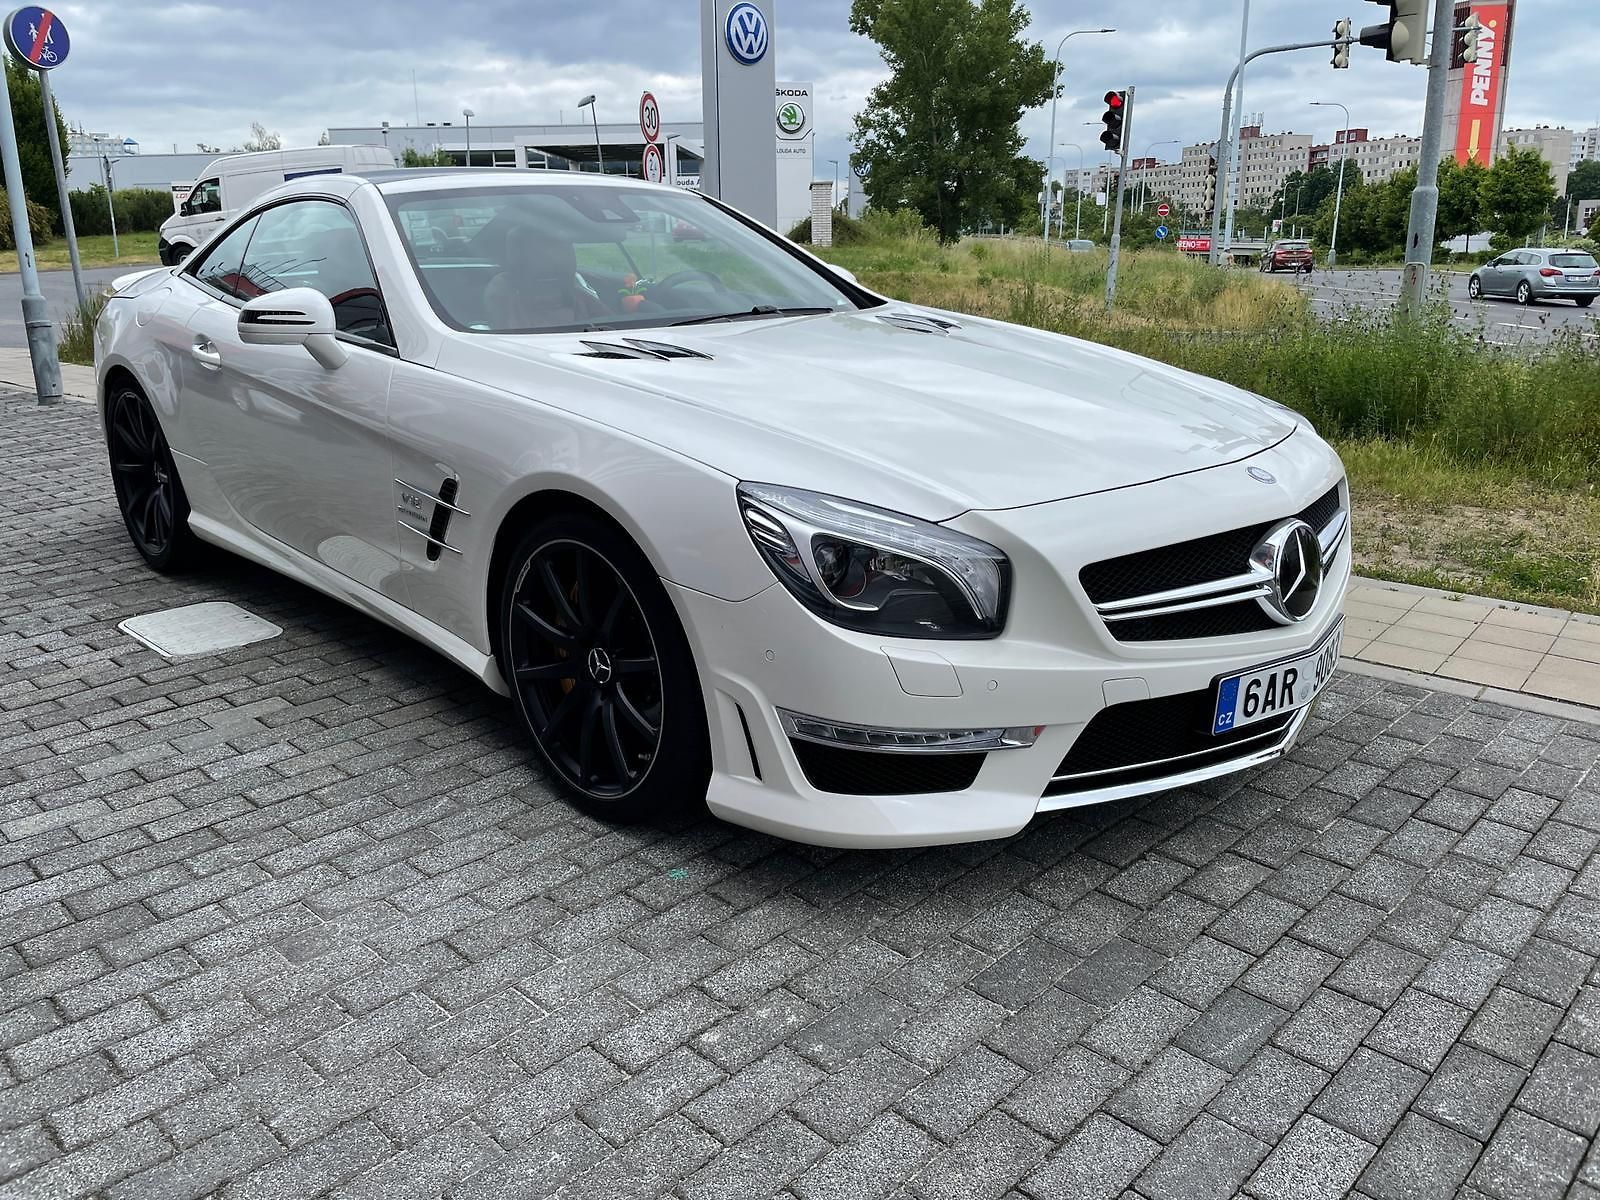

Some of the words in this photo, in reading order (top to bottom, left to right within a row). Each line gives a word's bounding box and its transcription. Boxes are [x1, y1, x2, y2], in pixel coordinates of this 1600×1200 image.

[728, 4, 768, 62] VW
[645, 106, 657, 130] 30
[676, 178, 695, 186] ouda
[1243, 667, 1298, 718] 6AR
[1218, 711, 1233, 726] CZ
